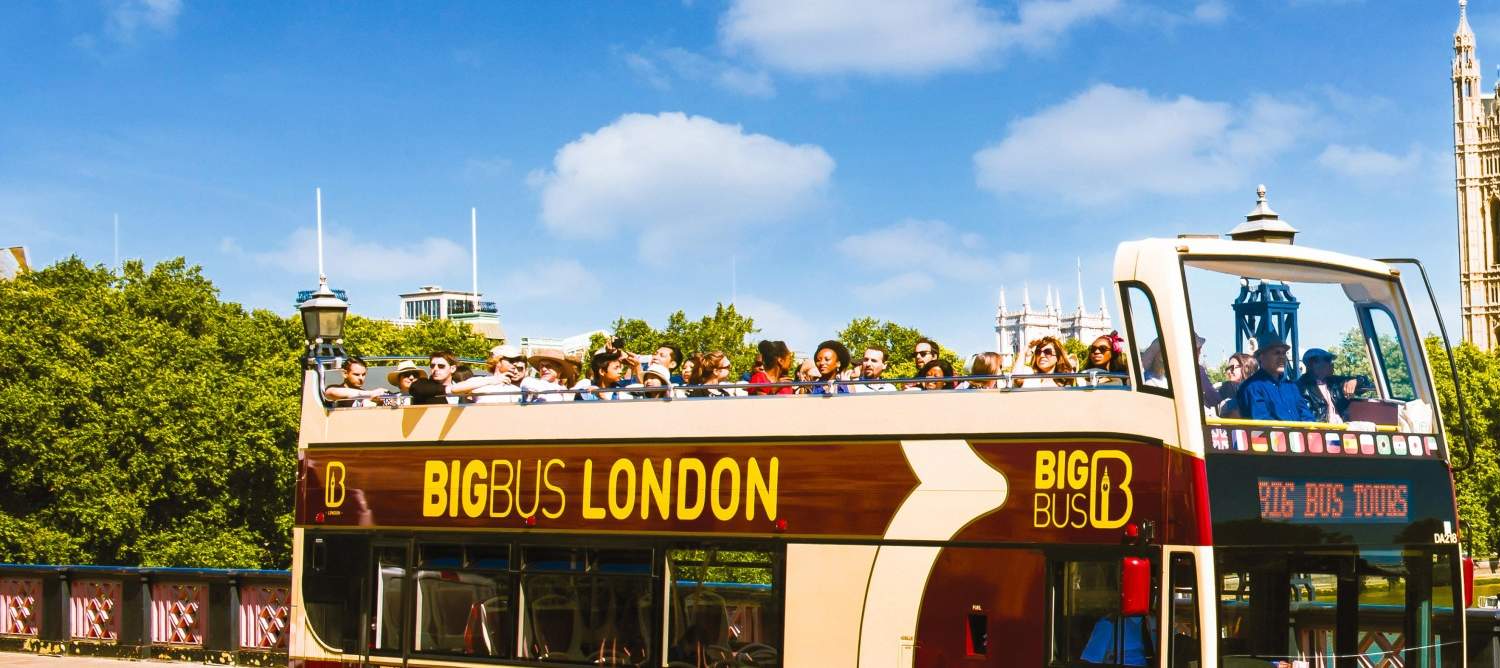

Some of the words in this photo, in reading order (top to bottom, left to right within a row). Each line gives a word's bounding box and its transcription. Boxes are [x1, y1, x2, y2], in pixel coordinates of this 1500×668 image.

[582, 457, 779, 521] LONDON
[1035, 450, 1088, 490] BIG
[1034, 493, 1087, 529] BUS
[1304, 482, 1344, 517] BUS
[1353, 484, 1408, 517] TOURS
